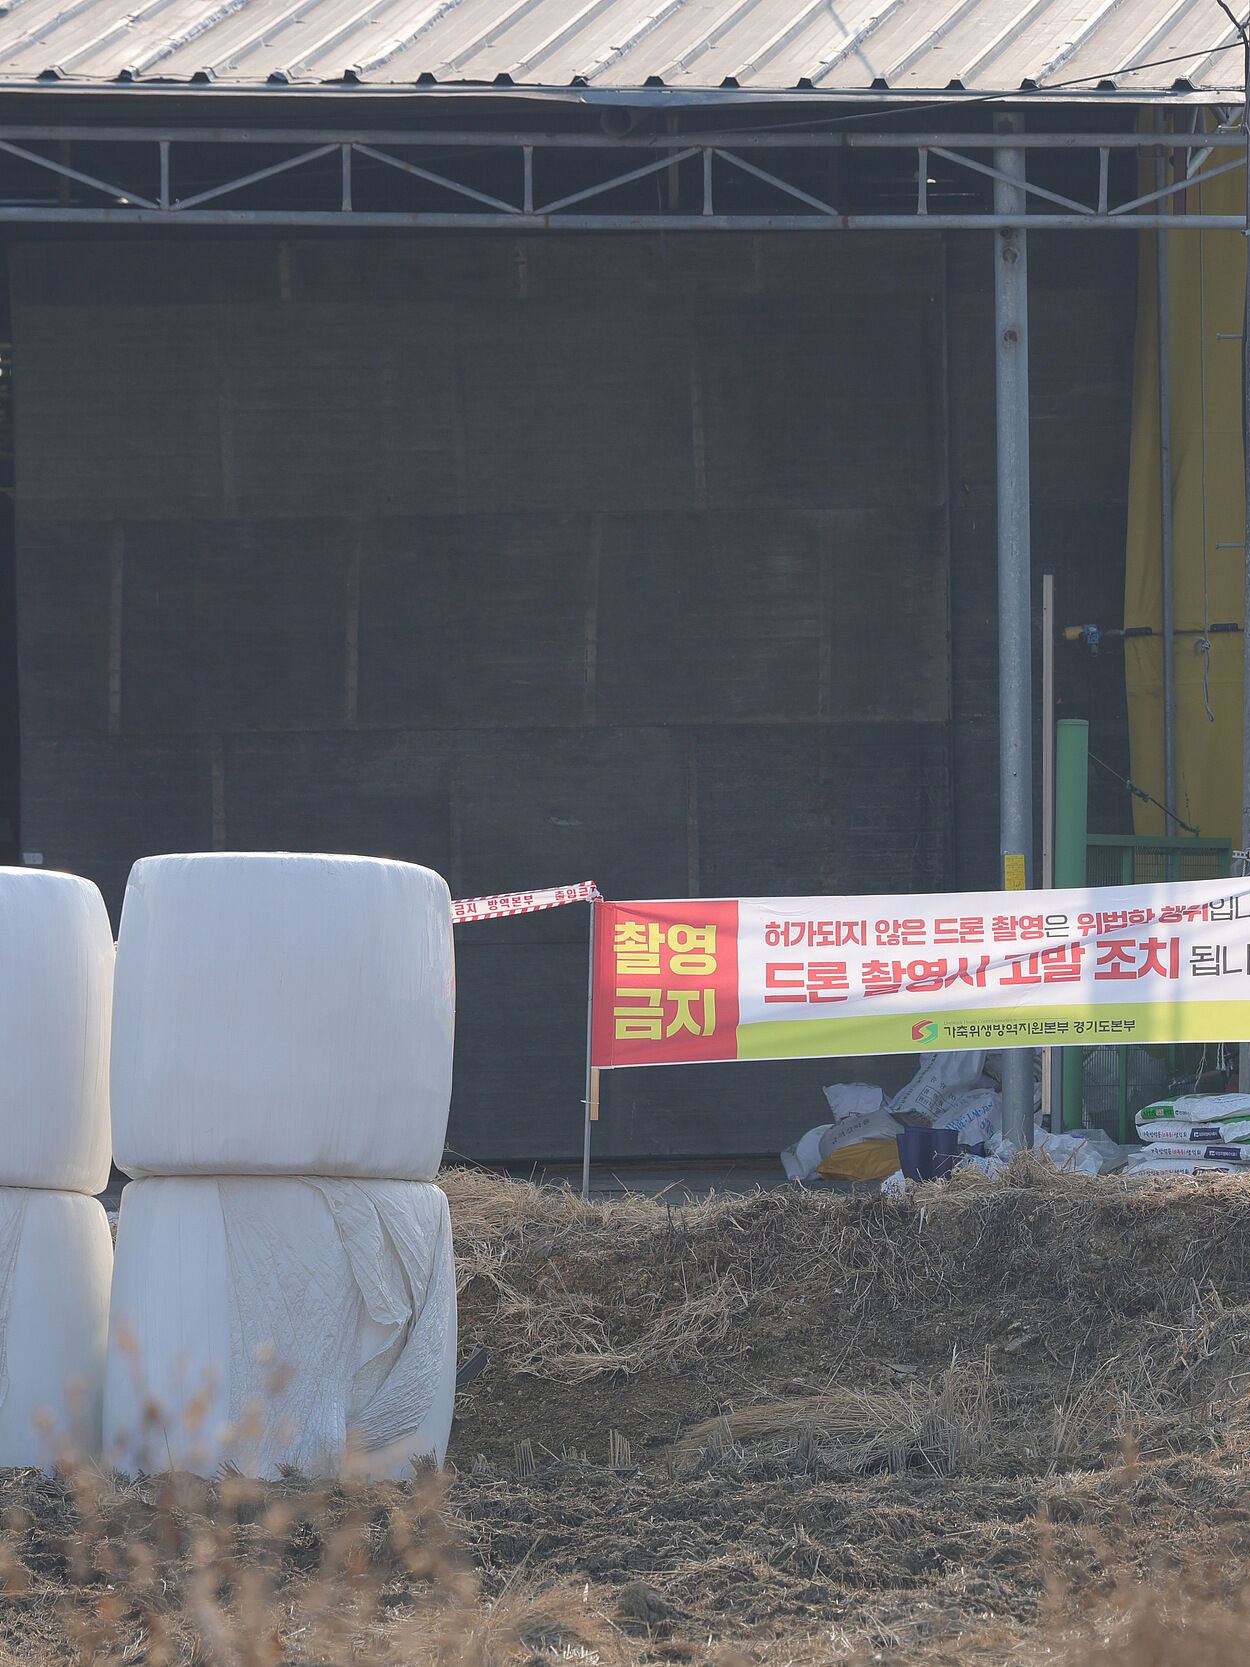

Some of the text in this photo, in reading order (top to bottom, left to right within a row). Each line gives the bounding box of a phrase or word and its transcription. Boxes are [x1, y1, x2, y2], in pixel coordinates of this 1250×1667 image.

[487, 894, 534, 911] 방역본부
[613, 920, 717, 976] 촬영
[765, 919, 867, 948] 허가되지
[875, 918, 926, 946] 않은
[934, 916, 985, 944] 드론
[991, 914, 1070, 942] 촬영은
[764, 961, 850, 1004] 드론
[861, 955, 991, 998] 촬영시
[999, 941, 1086, 986] 고발
[1094, 937, 1180, 981] 조치
[613, 988, 717, 1041] 금지
[943, 1019, 1136, 1039] 가축위생방역지원본부 경기도본부
